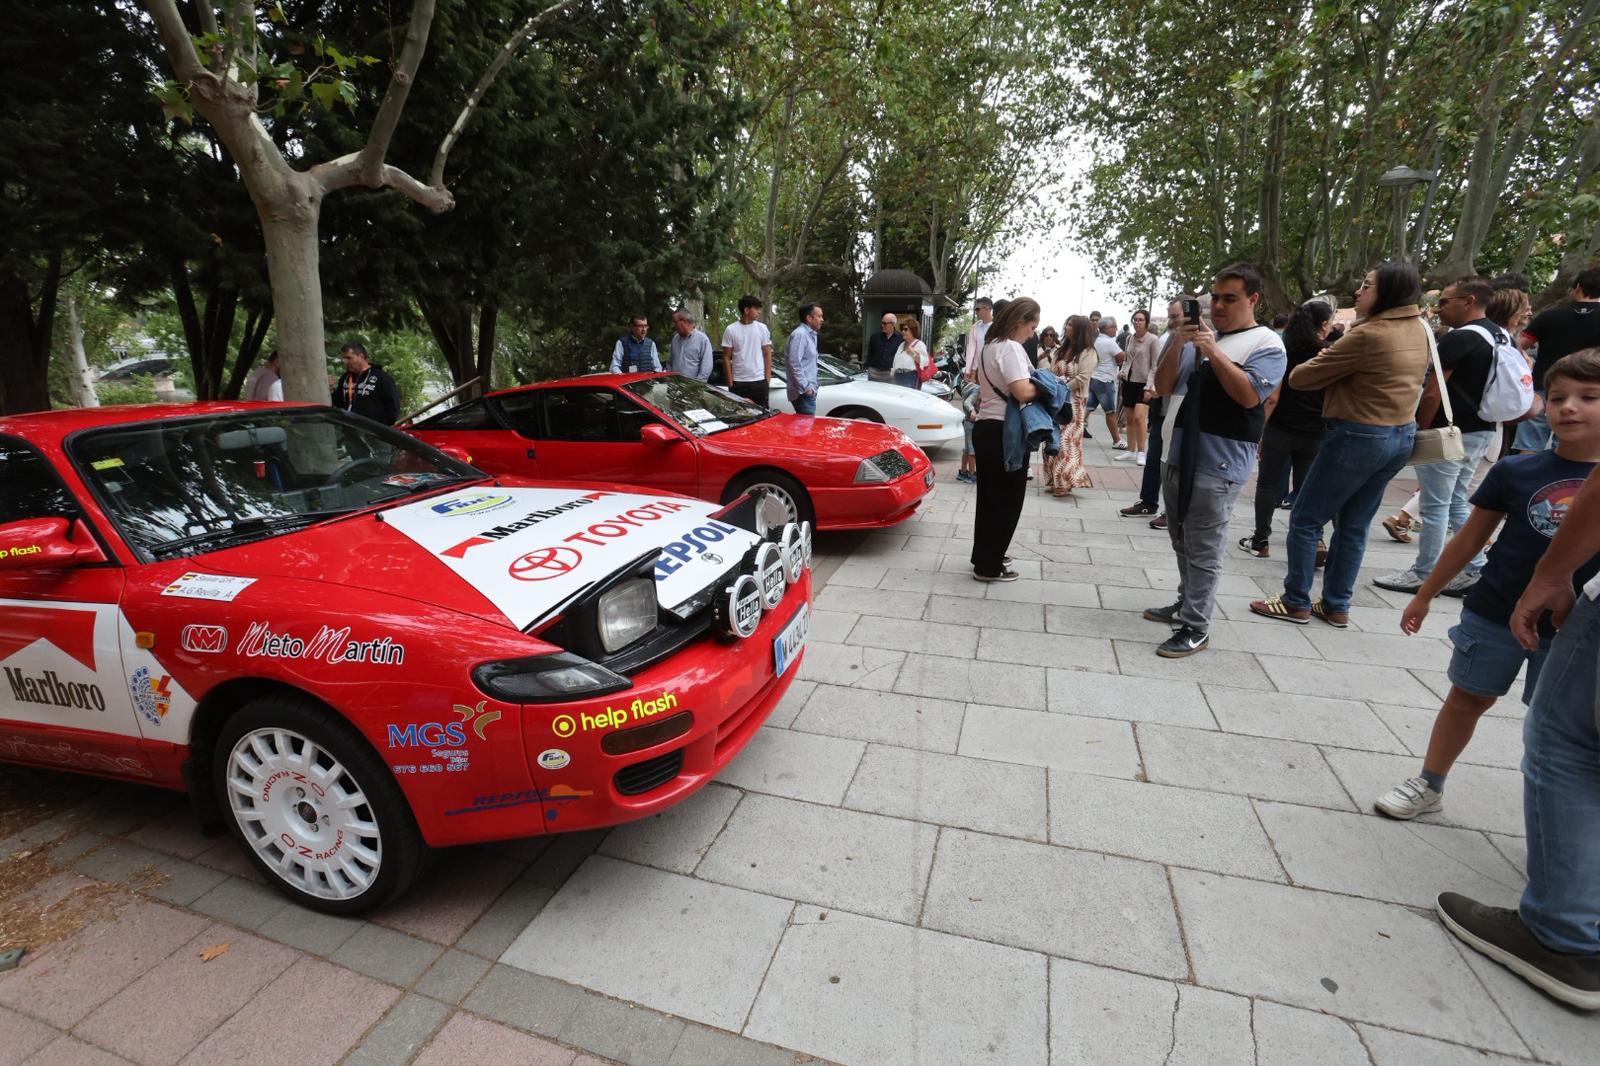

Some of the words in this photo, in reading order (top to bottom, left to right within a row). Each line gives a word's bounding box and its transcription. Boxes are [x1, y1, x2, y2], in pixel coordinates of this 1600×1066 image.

[481, 496, 593, 541] Marlboro
[563, 499, 692, 547] TOYOTA
[10, 544, 42, 556] flash
[765, 570, 783, 592] Hella
[739, 599, 760, 621] Hella
[237, 621, 304, 657] Nieto
[302, 625, 405, 664] Martín
[3, 666, 106, 712] Marlboro
[581, 706, 628, 731] help
[631, 691, 678, 719] flash
[387, 722, 467, 748] MGS
[263, 769, 290, 803] RACING
[315, 829, 344, 860] RACING
